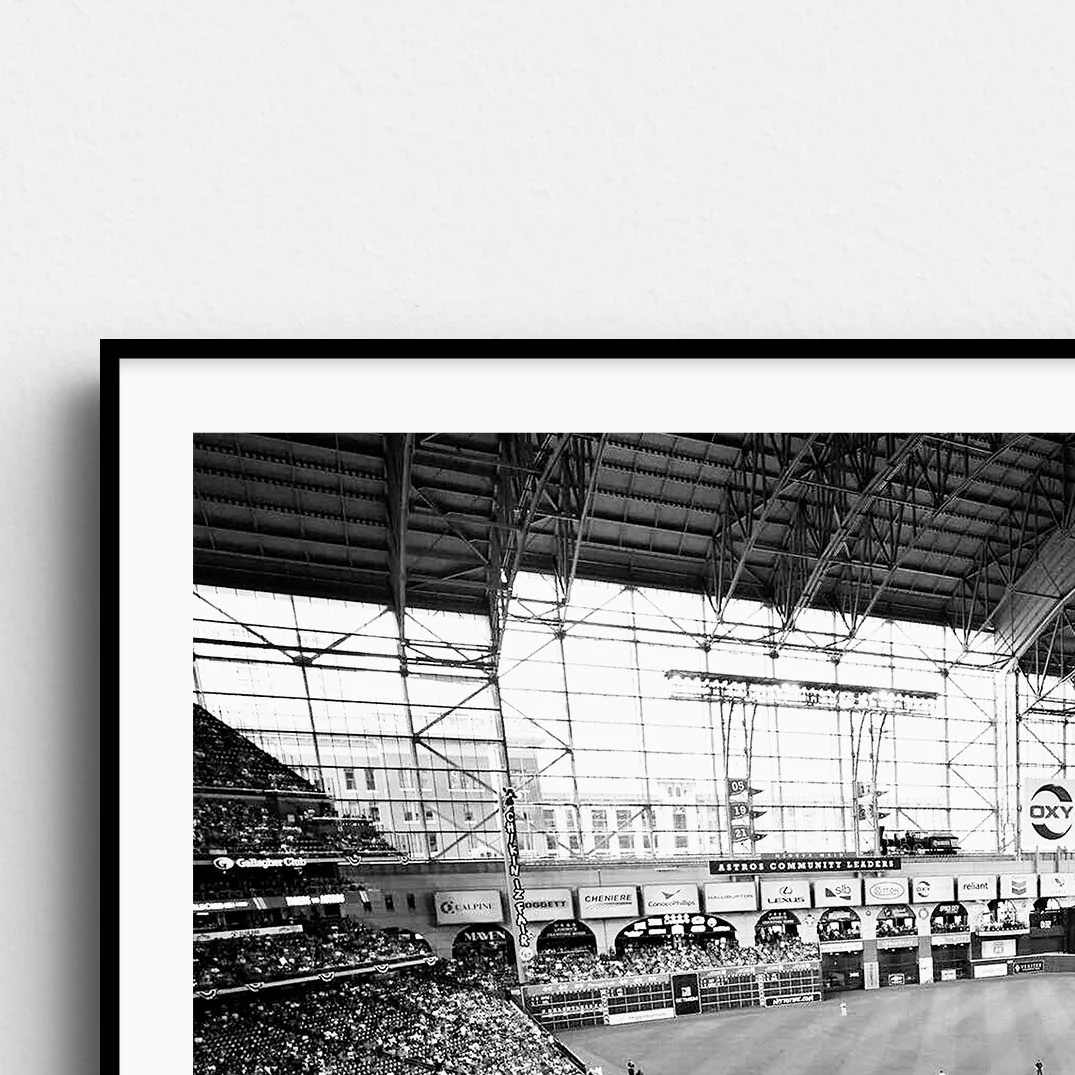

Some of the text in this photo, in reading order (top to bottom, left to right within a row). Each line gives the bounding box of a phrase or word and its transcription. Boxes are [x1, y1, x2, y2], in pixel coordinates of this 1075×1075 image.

[731, 780, 745, 791] 05
[733, 805, 747, 815] 19
[1030, 805, 1074, 818] OXY
[733, 828, 747, 839] 21
[505, 812, 519, 876] CHIKIN
[718, 860, 895, 872] ASTROS COMMUNITY LEADERS
[513, 878, 525, 900] IZ
[963, 882, 989, 890] reliant
[584, 894, 633, 903] CHENIERE
[524, 900, 566, 909] OGGETT
[514, 902, 530, 946] FAIR
